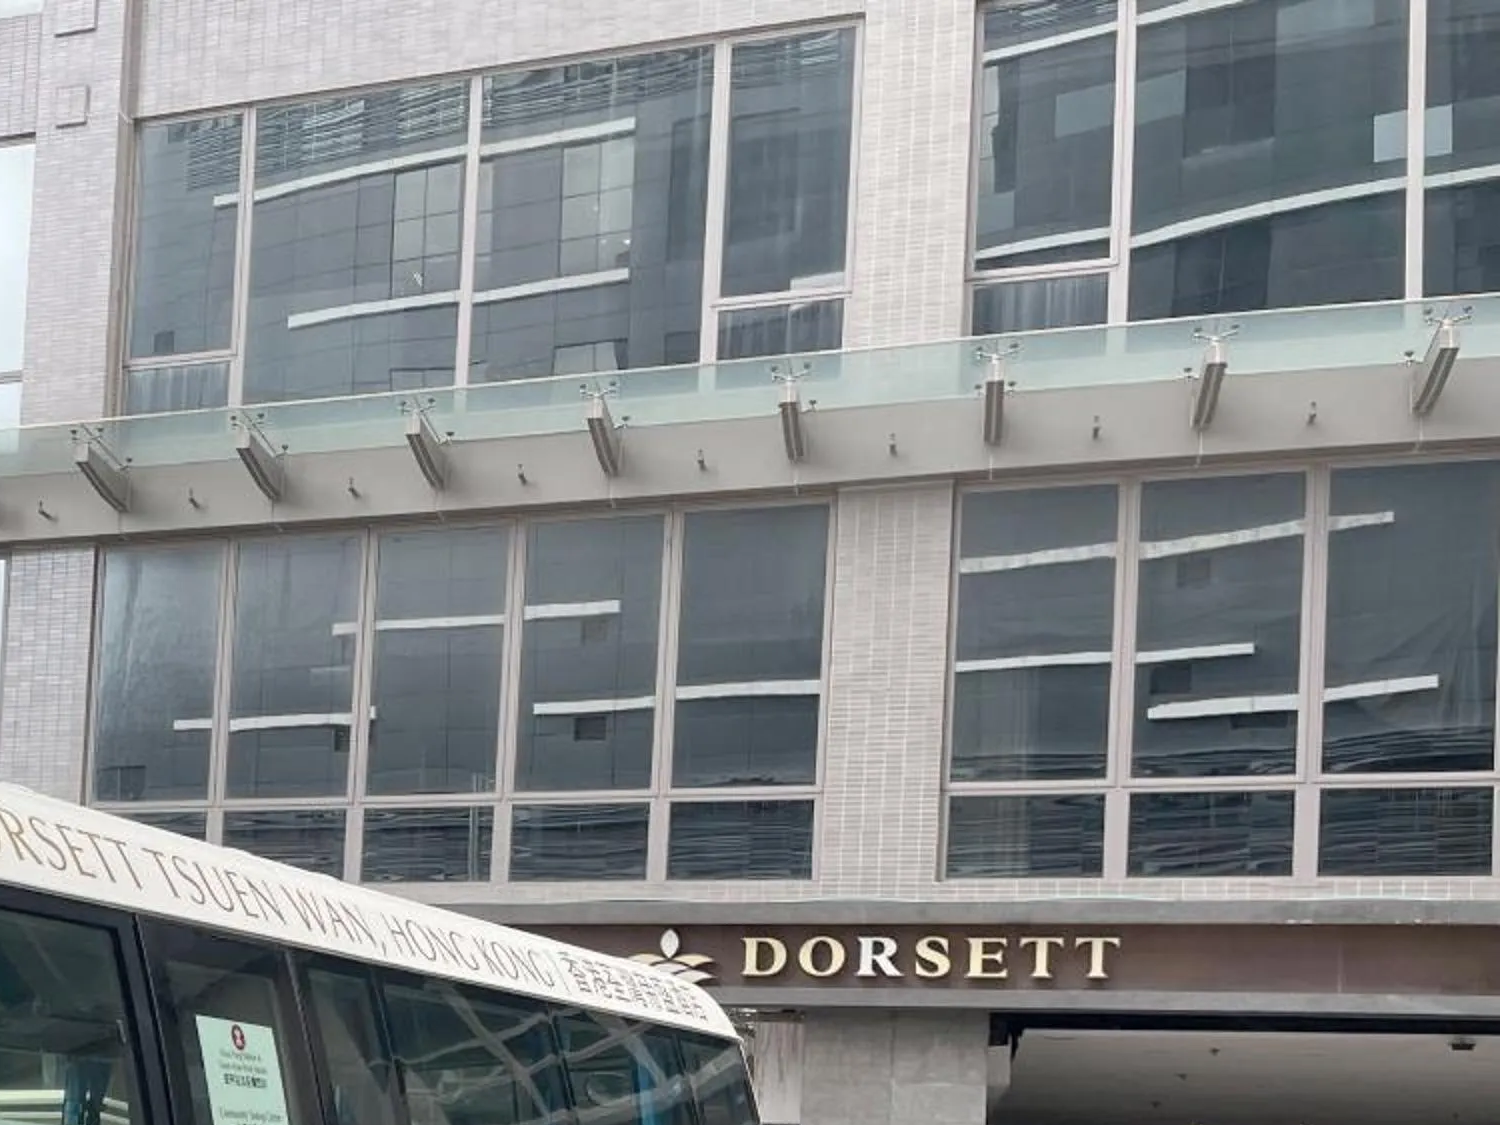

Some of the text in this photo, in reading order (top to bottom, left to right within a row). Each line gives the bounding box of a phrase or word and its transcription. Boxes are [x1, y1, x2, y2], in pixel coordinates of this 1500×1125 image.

[141, 846, 287, 926] TSUEN
[379, 911, 480, 972] HONG
[472, 933, 555, 988] KONG
[740, 935, 1122, 980] DORSETT
